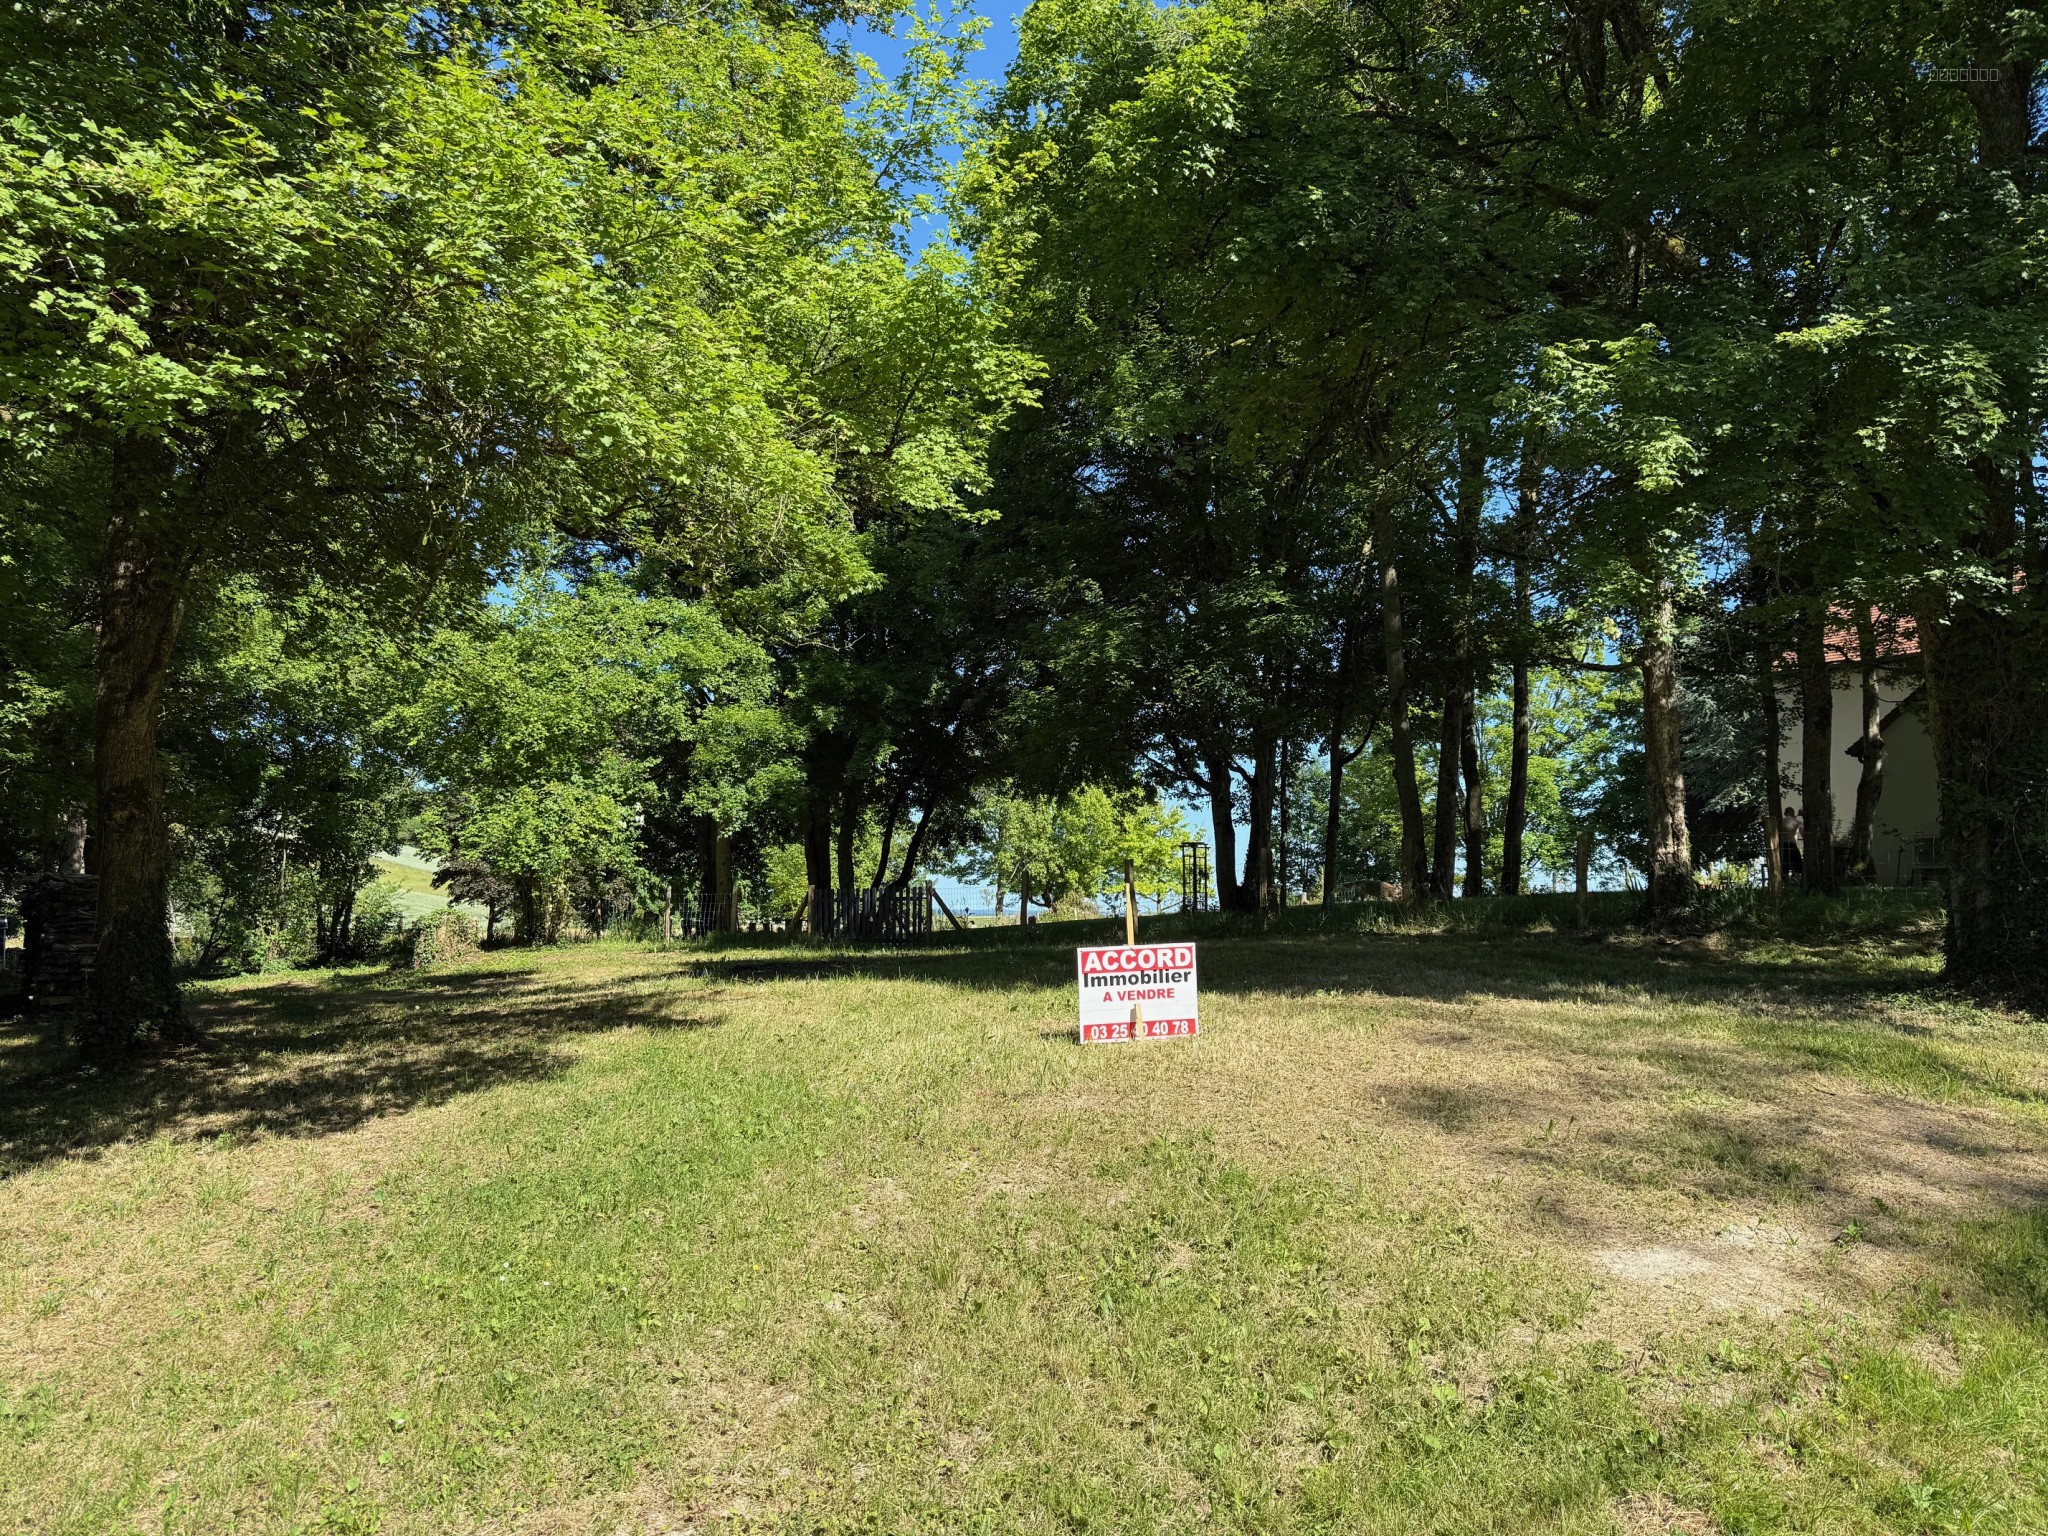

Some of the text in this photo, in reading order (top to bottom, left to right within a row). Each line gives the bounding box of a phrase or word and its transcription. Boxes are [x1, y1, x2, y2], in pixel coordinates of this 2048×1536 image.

[1084, 948, 1192, 972] ACCORD
[1083, 969, 1191, 987] Immobilier
[1103, 988, 1175, 1002] A VENDRE
[1091, 1026, 1108, 1039] 03
[1112, 1024, 1128, 1037] 25
[1152, 1022, 1168, 1035] 40
[1172, 1020, 1189, 1034] 78
